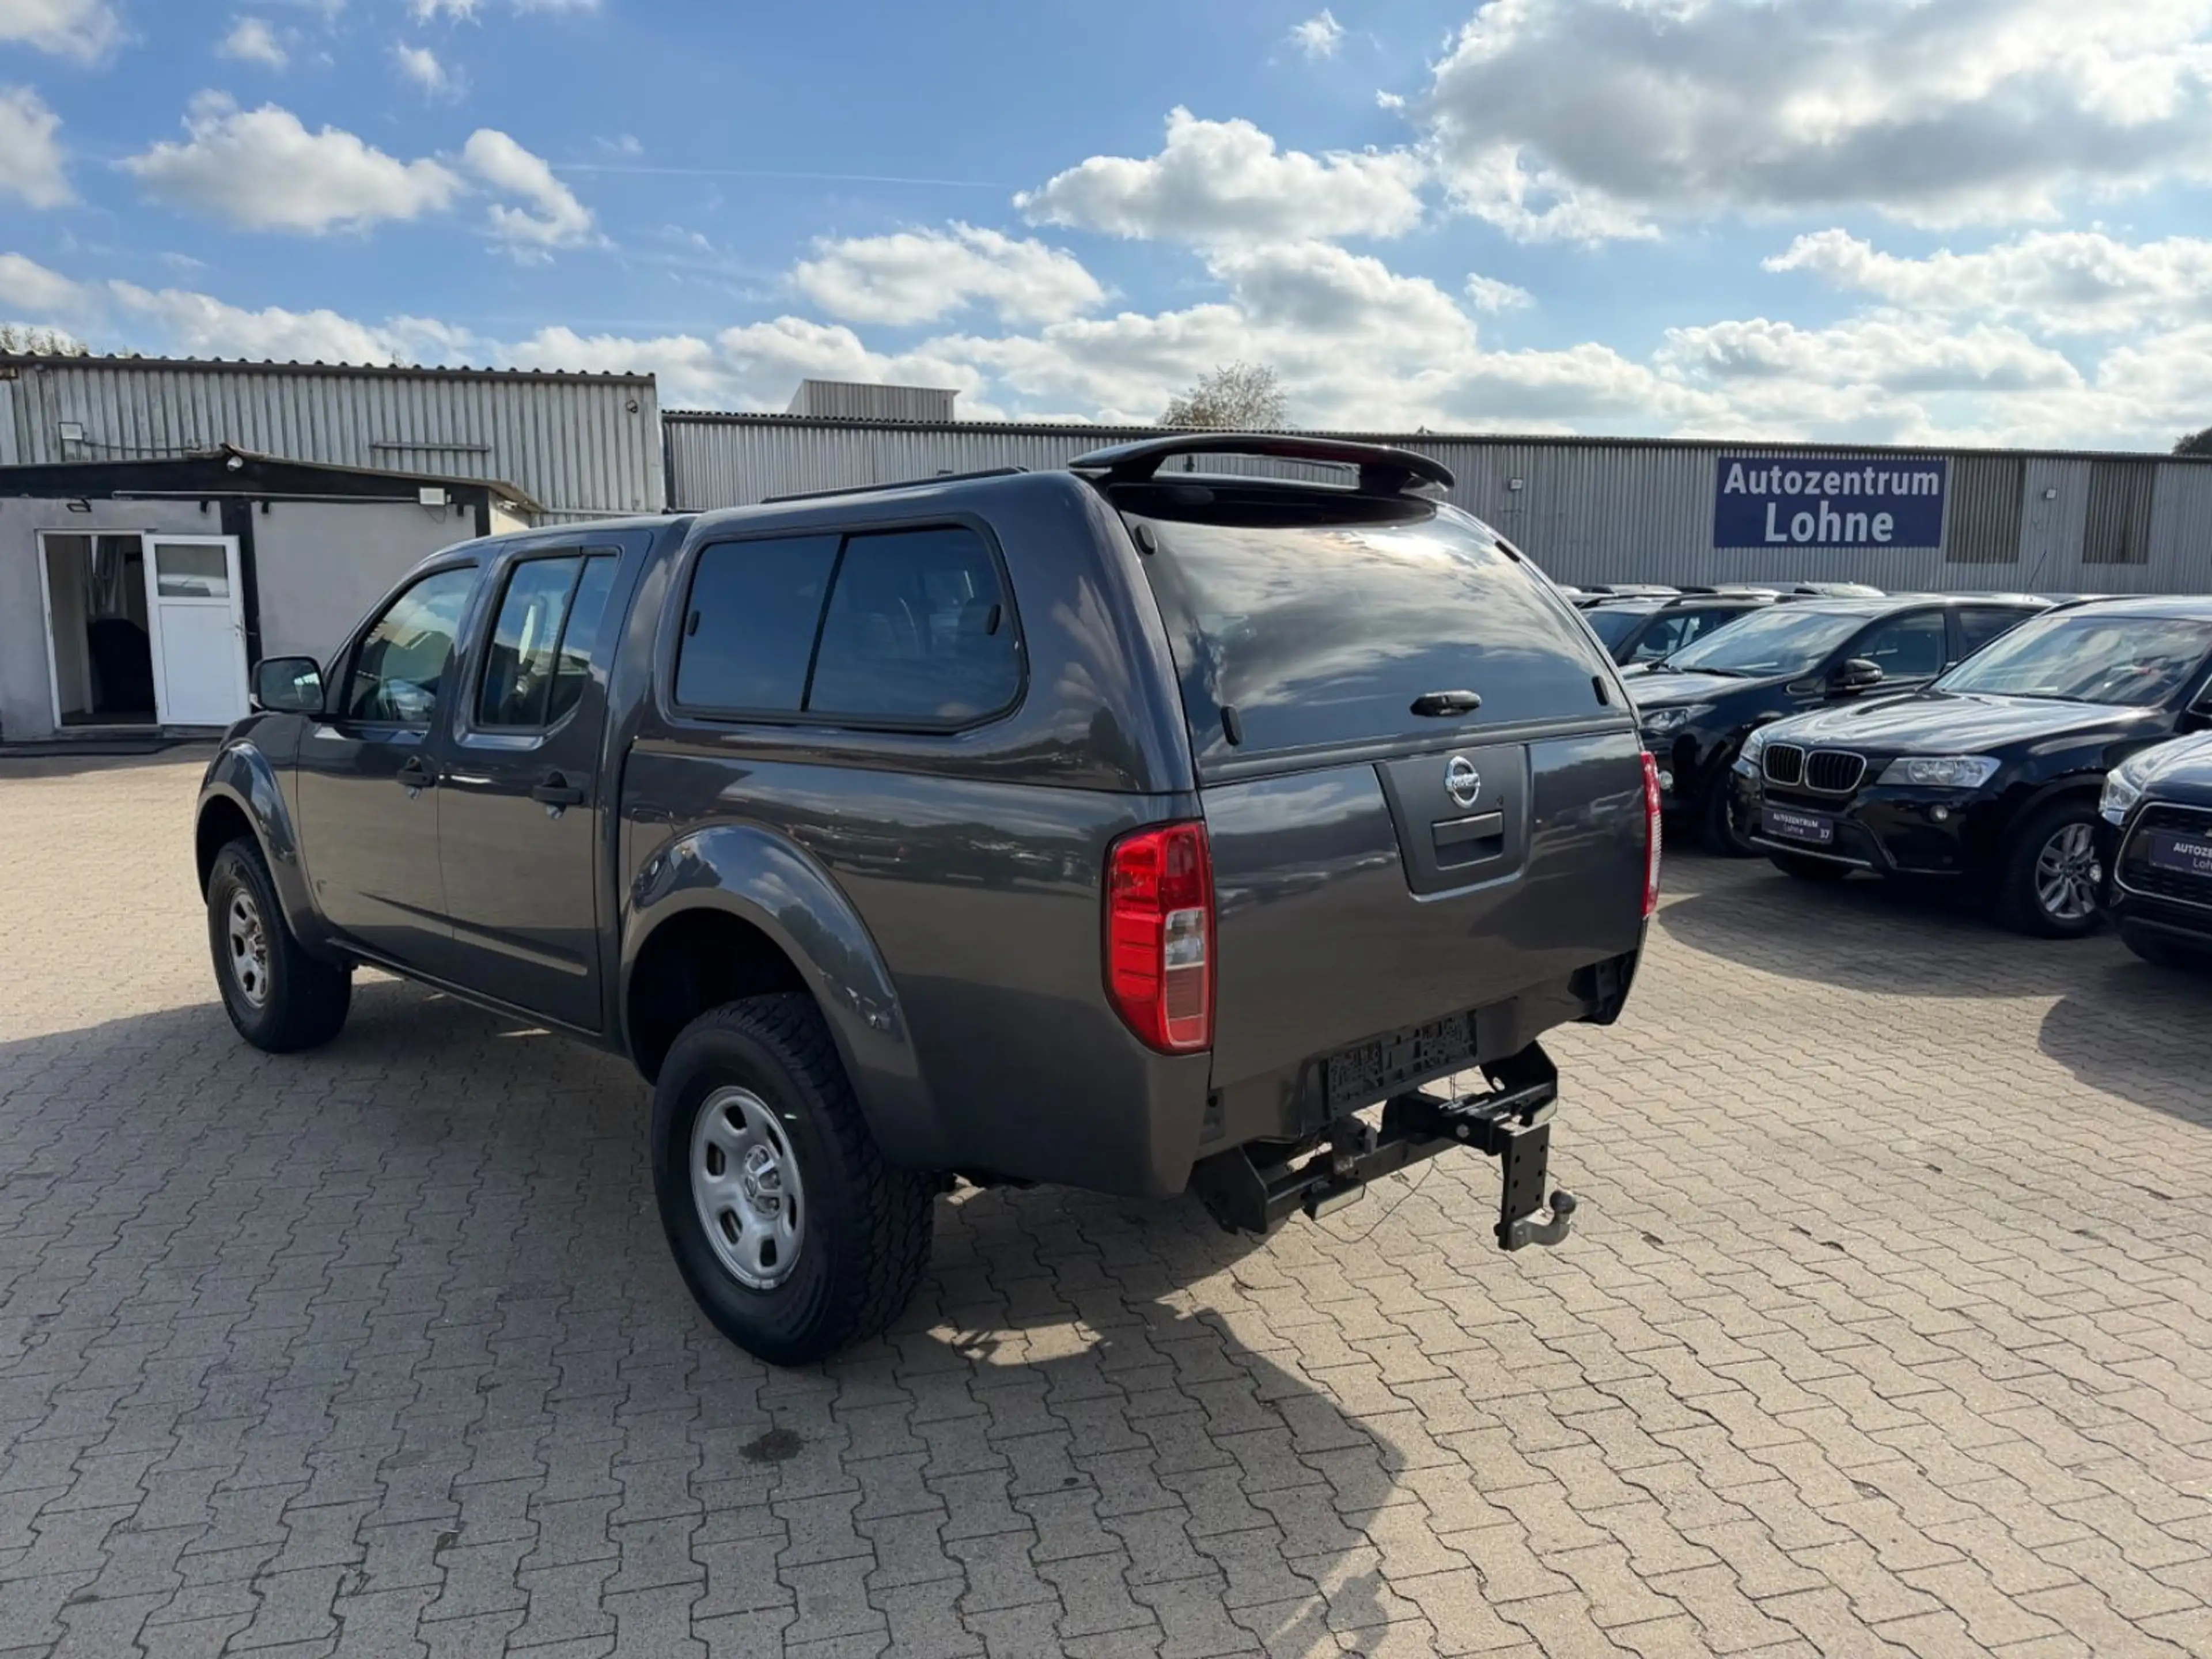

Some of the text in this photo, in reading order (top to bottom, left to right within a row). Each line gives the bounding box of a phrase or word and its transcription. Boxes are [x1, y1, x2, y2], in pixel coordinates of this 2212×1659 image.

[1724, 463, 1939, 496] Autozentrum
[1765, 501, 1893, 542] Lohne
[2192, 857, 2212, 872] Loh
